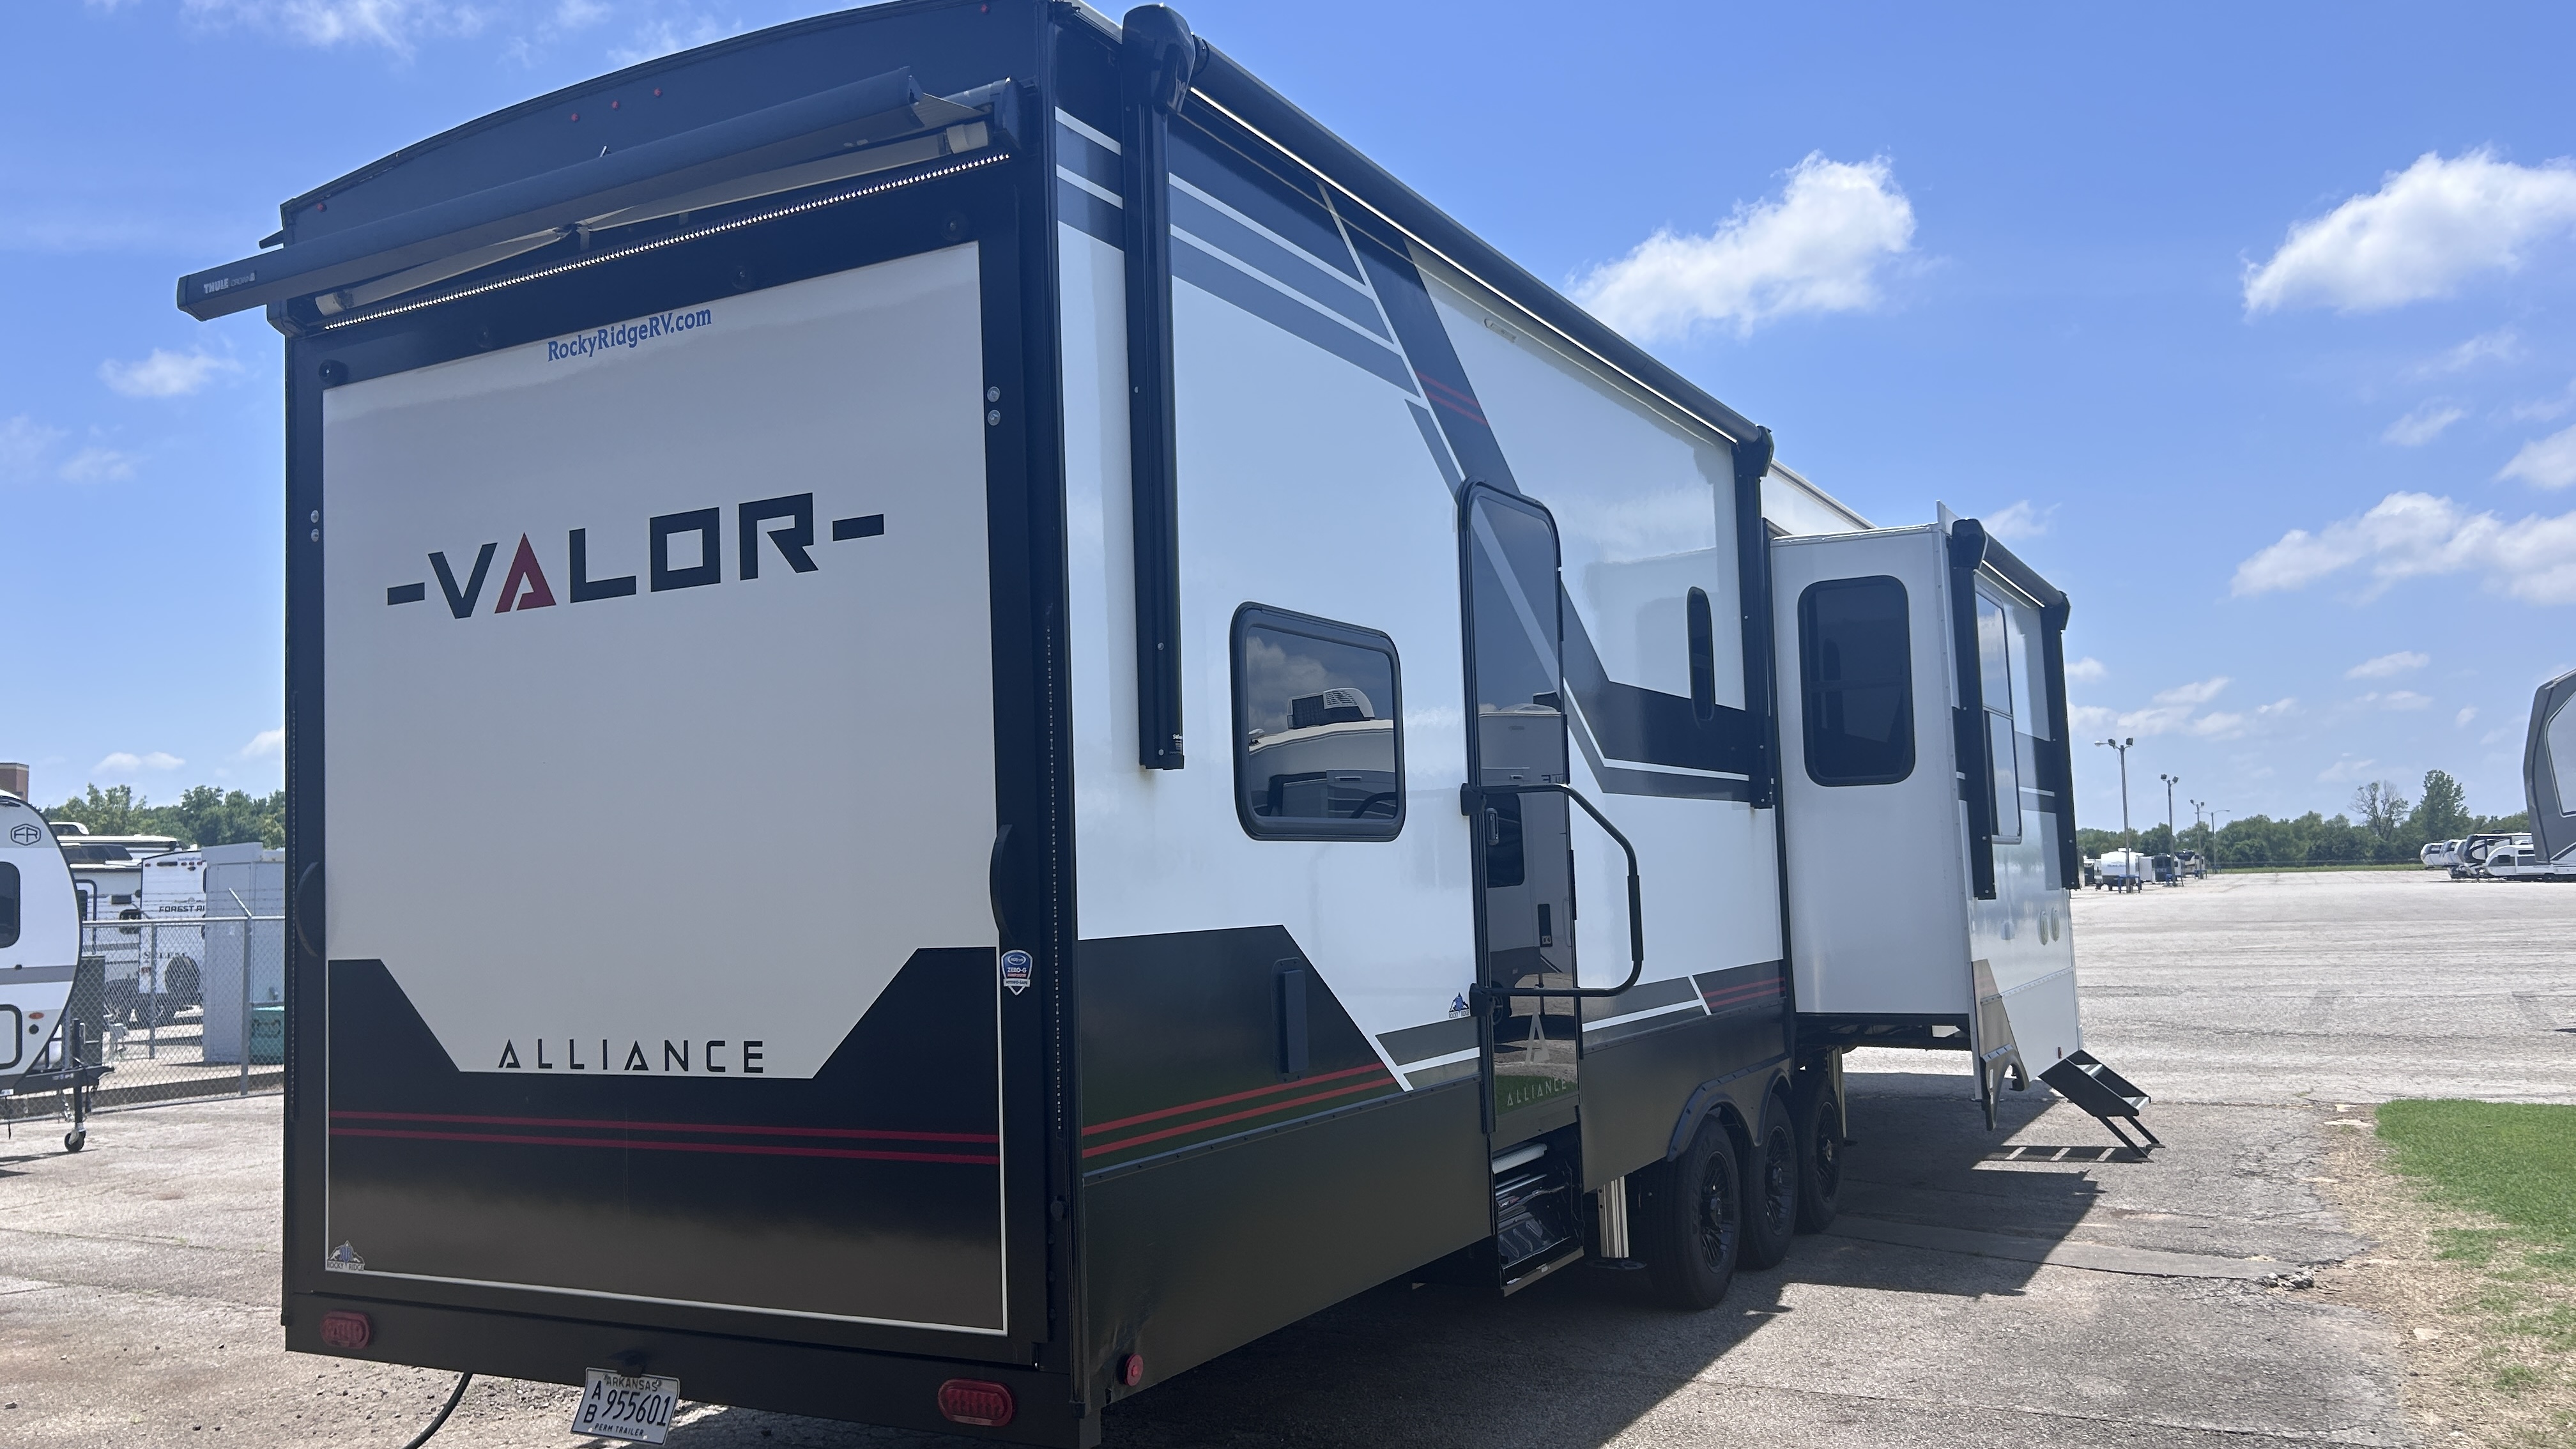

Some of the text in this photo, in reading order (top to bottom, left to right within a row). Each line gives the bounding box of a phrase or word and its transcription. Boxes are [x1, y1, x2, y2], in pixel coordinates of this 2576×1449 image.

[204, 278, 229, 294] THULE
[548, 309, 712, 362] RockyRidgeRV.com
[498, 1038, 763, 1073] ALLIANCE
[1507, 1078, 1567, 1107] ALLIANCE
[327, 1261, 344, 1269] ROCKY
[592, 1380, 602, 1400] A
[606, 1376, 658, 1392] ARKANSAS
[583, 1404, 597, 1423] B
[602, 1389, 671, 1426] 955601
[594, 1423, 644, 1436] PERM TRAILER
